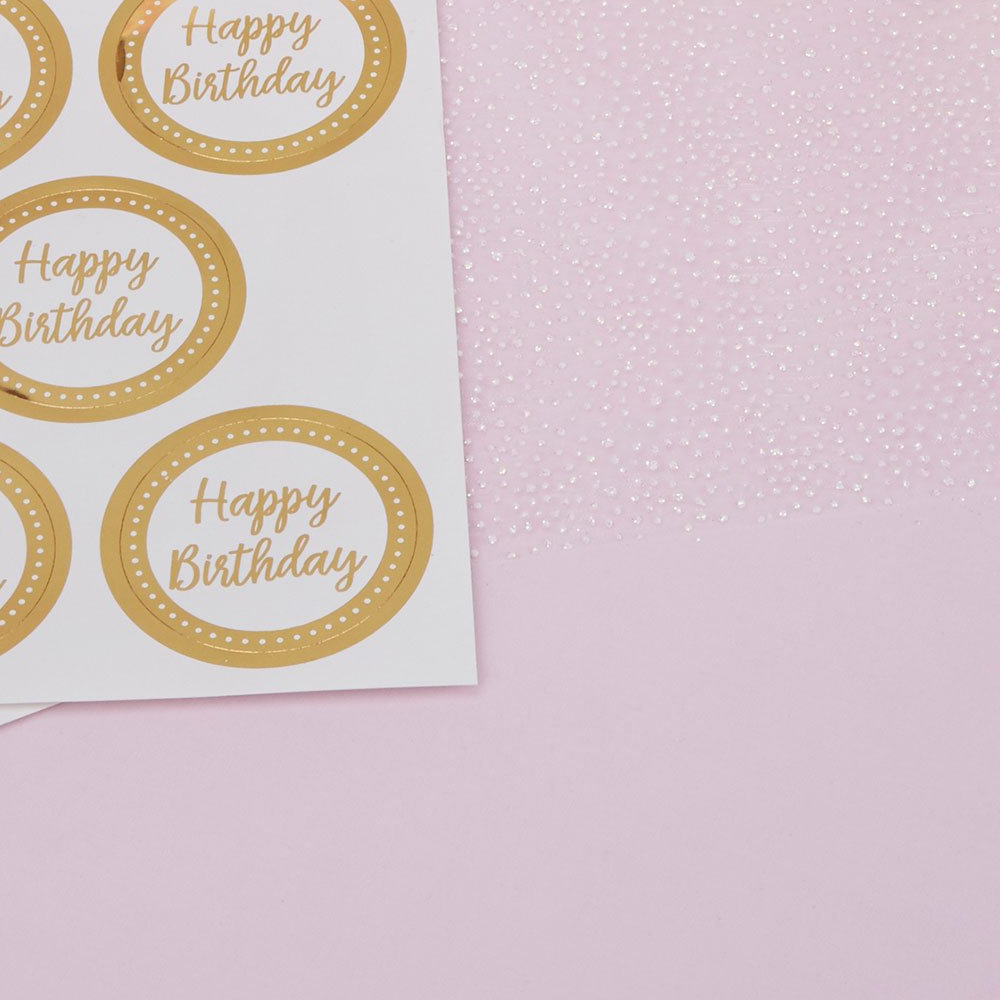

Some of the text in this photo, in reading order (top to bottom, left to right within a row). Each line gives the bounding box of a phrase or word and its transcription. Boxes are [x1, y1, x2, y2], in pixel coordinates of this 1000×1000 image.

[181, 5, 321, 57] Happy
[161, 56, 345, 109] Birthday
[14, 240, 159, 296] Happy
[188, 476, 341, 537] Happy
[168, 535, 368, 593] Birthday
